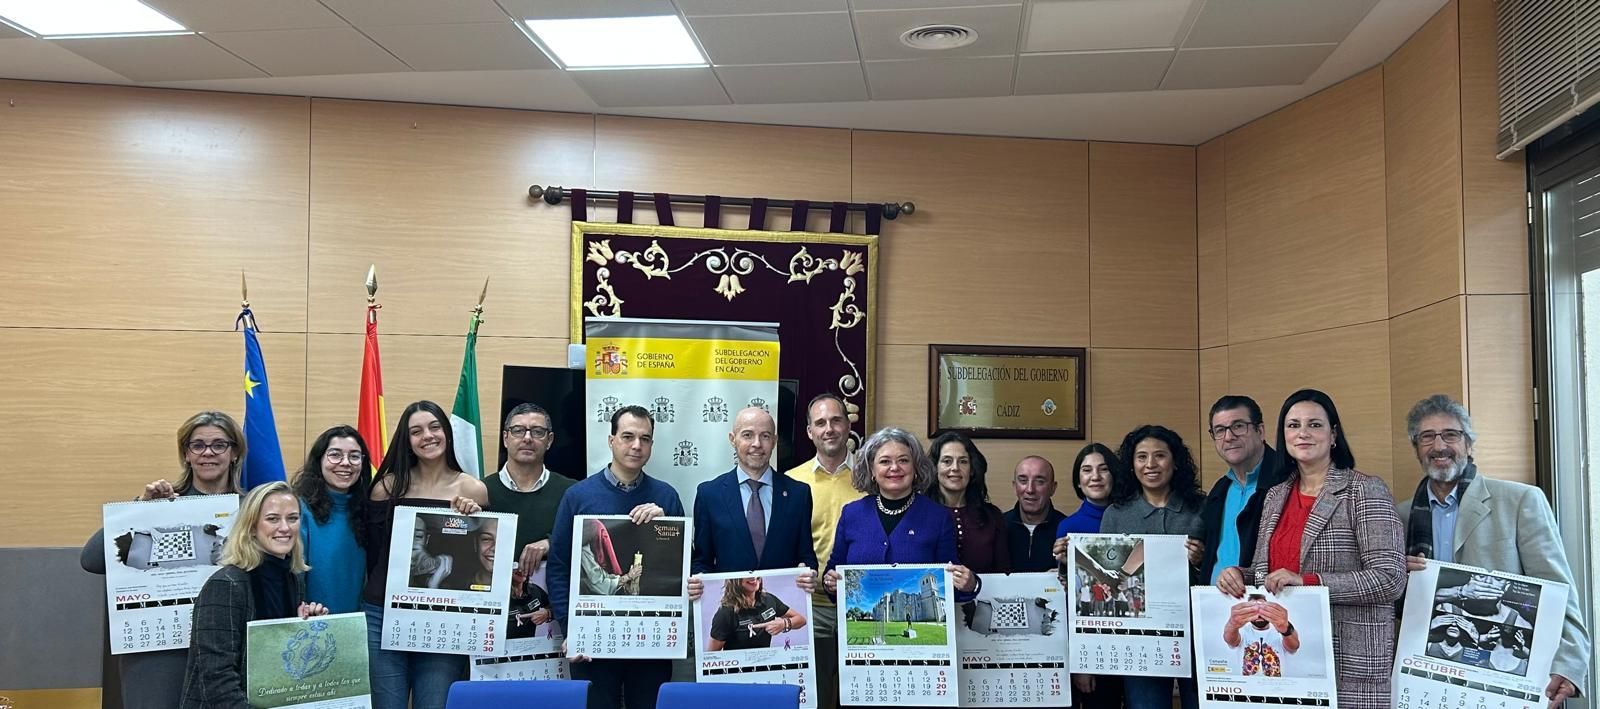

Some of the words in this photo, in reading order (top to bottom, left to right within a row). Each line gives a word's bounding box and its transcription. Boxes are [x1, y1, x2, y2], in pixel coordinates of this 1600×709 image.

[947, 365, 1010, 380] SUBDELEGACIÓN
[1014, 368, 1028, 381] DEL
[1030, 368, 1068, 382] GOBIERNO
[997, 402, 1020, 417] CÁDIZ
[116, 594, 150, 602] MAYO
[392, 595, 456, 604] NOVIEMBRE
[1403, 658, 1466, 677] OCTUBRE
[258, 687, 287, 696] Dedicado
